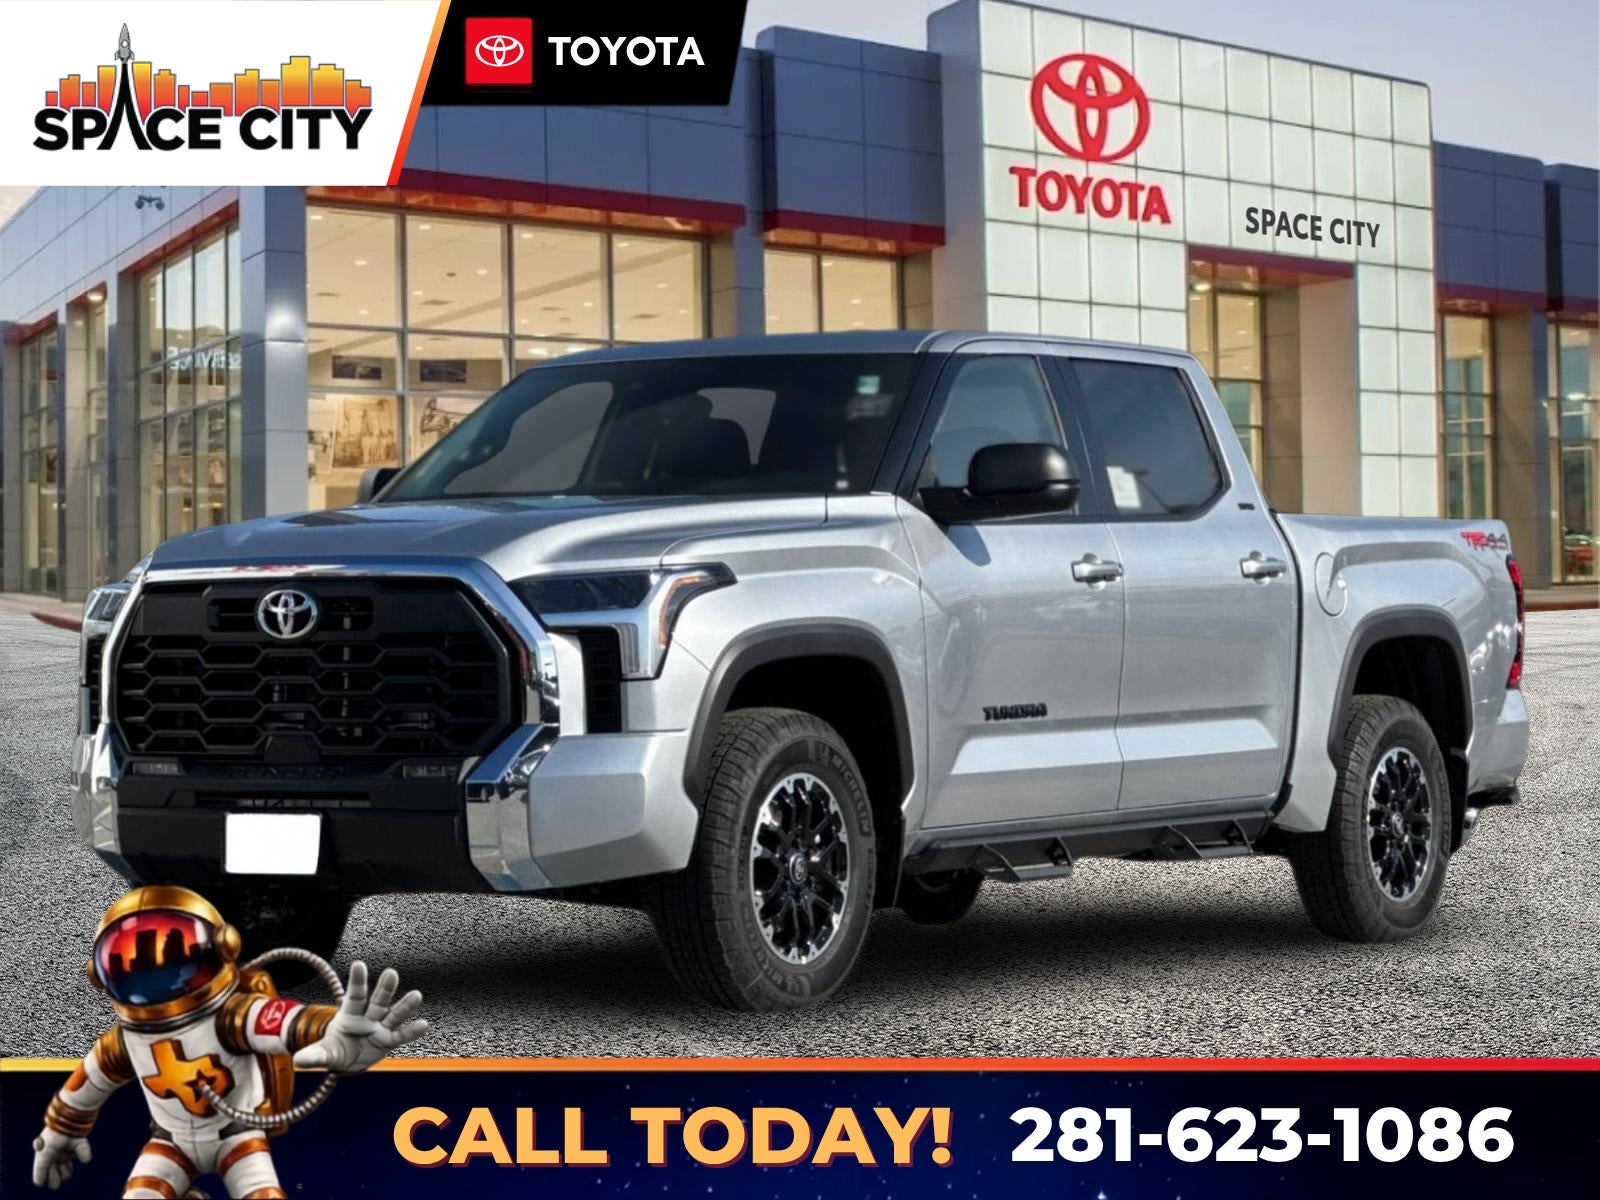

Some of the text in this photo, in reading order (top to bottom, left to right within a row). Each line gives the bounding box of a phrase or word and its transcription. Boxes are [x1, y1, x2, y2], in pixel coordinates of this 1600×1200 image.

[1009, 166, 1171, 224] TOYOTA
[1245, 207, 1380, 248] SPACE CITY
